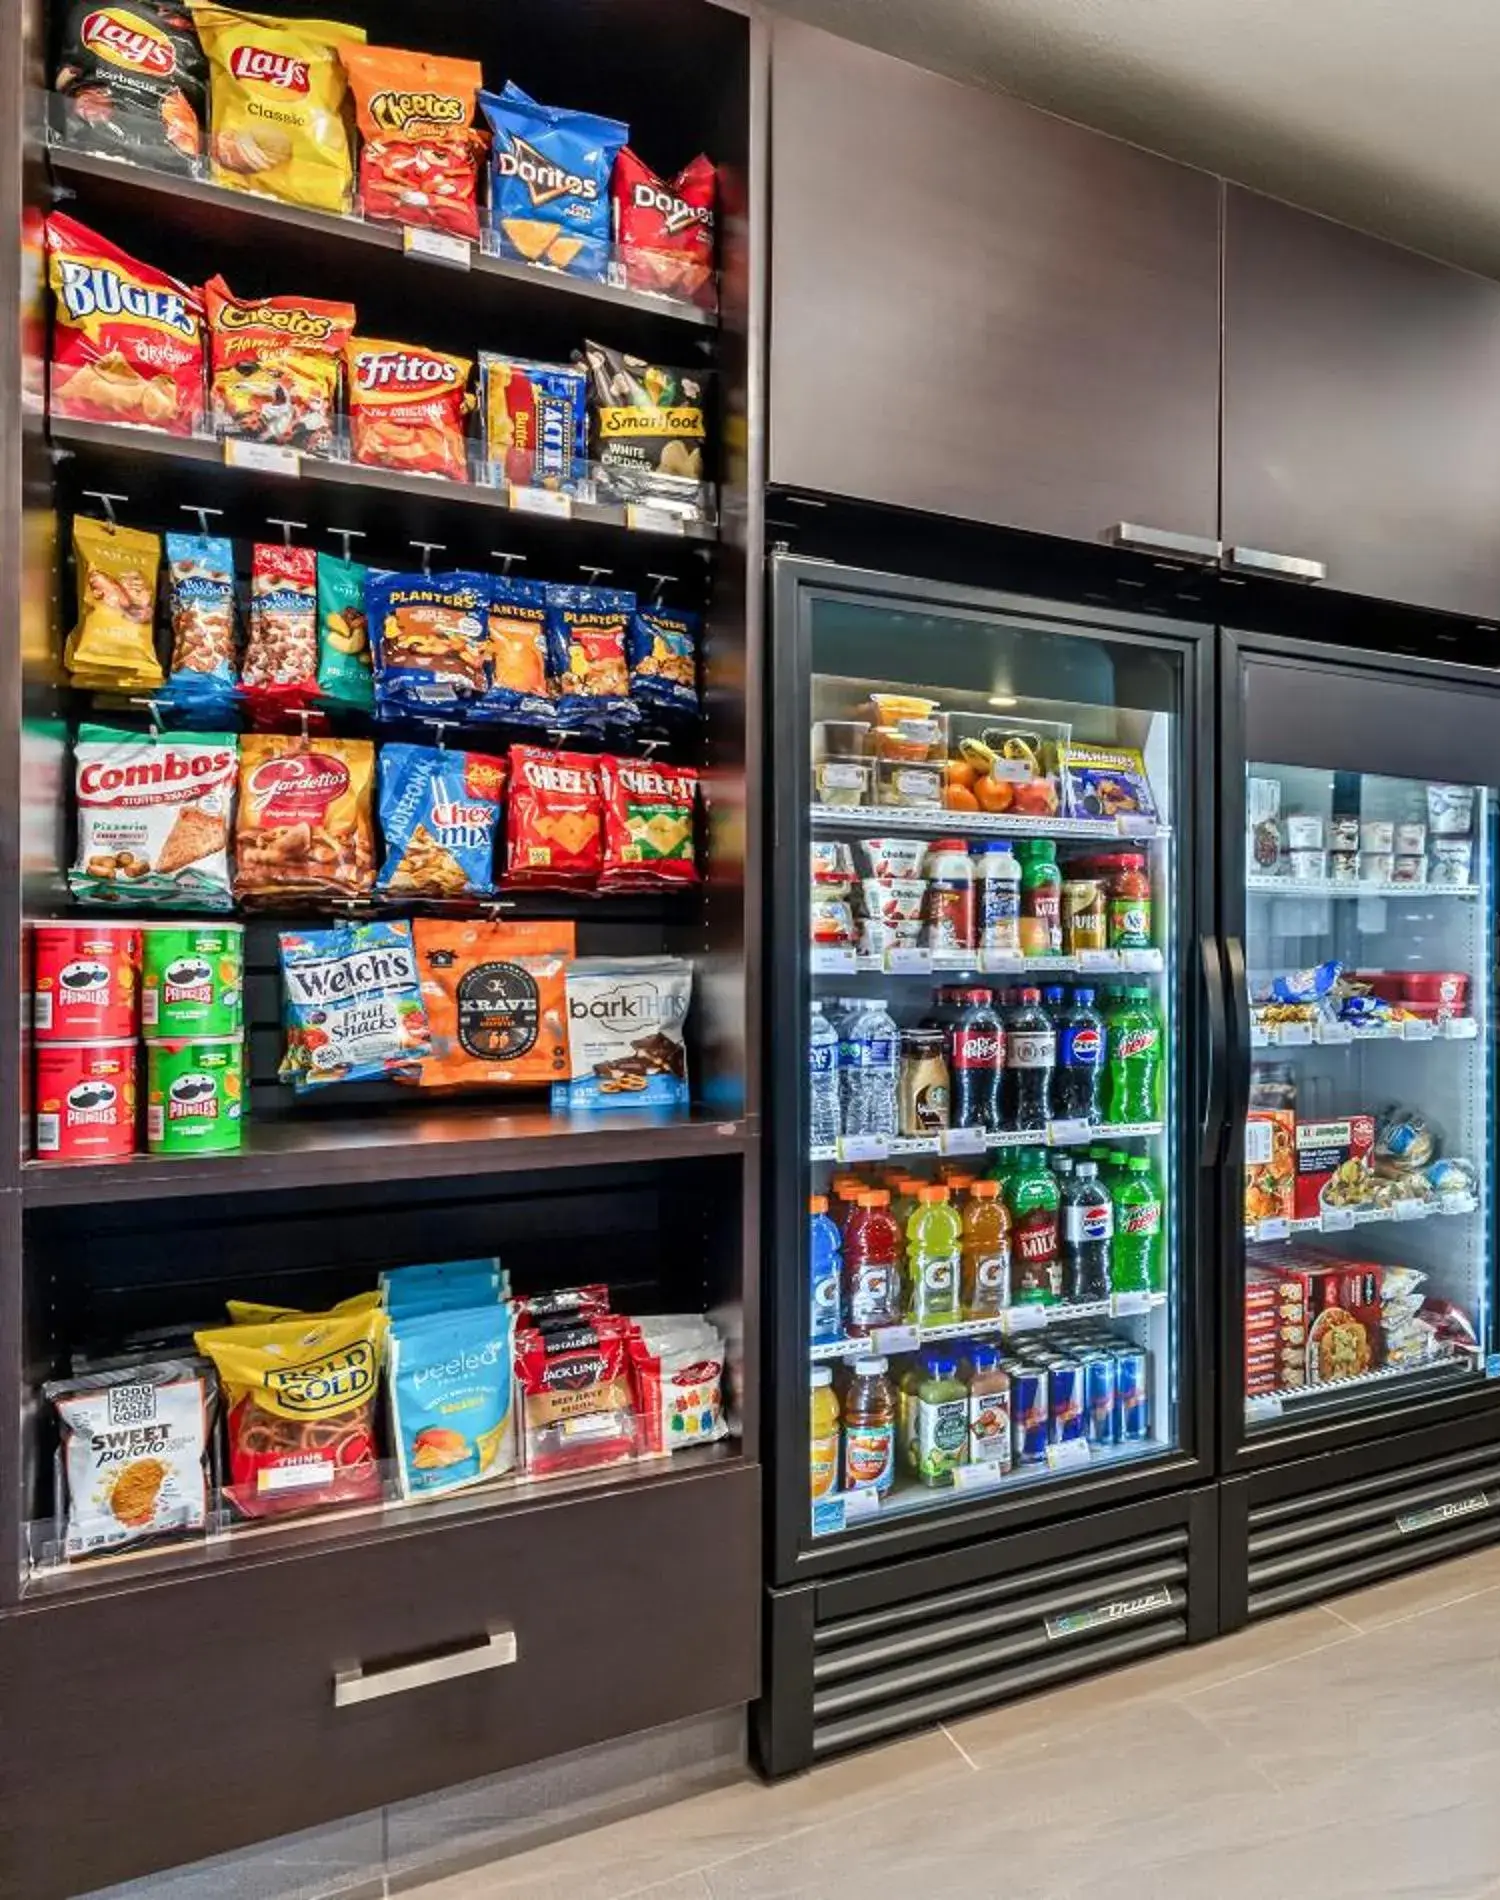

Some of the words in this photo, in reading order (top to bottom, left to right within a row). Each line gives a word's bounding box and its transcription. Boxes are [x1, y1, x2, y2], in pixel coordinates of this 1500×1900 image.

[88, 15, 170, 67] Lay's
[236, 47, 305, 87] Lay's
[247, 102, 305, 126] Classic
[369, 91, 463, 130] Cheetos
[500, 152, 597, 200] Doritos
[59, 259, 196, 337] BUGLES
[357, 351, 457, 390] Fritos
[600, 452, 651, 472] CHEDDAR
[608, 442, 646, 459] WHITE
[389, 591, 476, 609] PLANTERS
[490, 603, 546, 620] ANTERS
[564, 611, 629, 625] PLANTERS
[80, 751, 232, 795] Combos
[248, 758, 347, 812] Gardetto's
[433, 803, 493, 826] Chex
[299, 953, 411, 1001] Welch's
[59, 988, 110, 1006] PRINGLES
[165, 984, 211, 1003] PRINGLES
[461, 998, 537, 1011] KRAVE
[343, 1003, 385, 1025] Fruit
[331, 1017, 397, 1042] Snacks
[67, 1108, 117, 1126] PRINGLES
[169, 1099, 216, 1118] PRINGLES
[1021, 1234, 1057, 1258] MILK
[926, 1262, 952, 1289] G
[277, 1348, 367, 1386] ROLD
[542, 1365, 573, 1382] JACK
[111, 1385, 151, 1397] FOOD
[284, 1367, 369, 1402] GOLD
[112, 1401, 152, 1412] TASTE
[112, 1409, 152, 1423] GOOD
[91, 1423, 172, 1451] SWEET
[95, 1440, 166, 1469] potato
